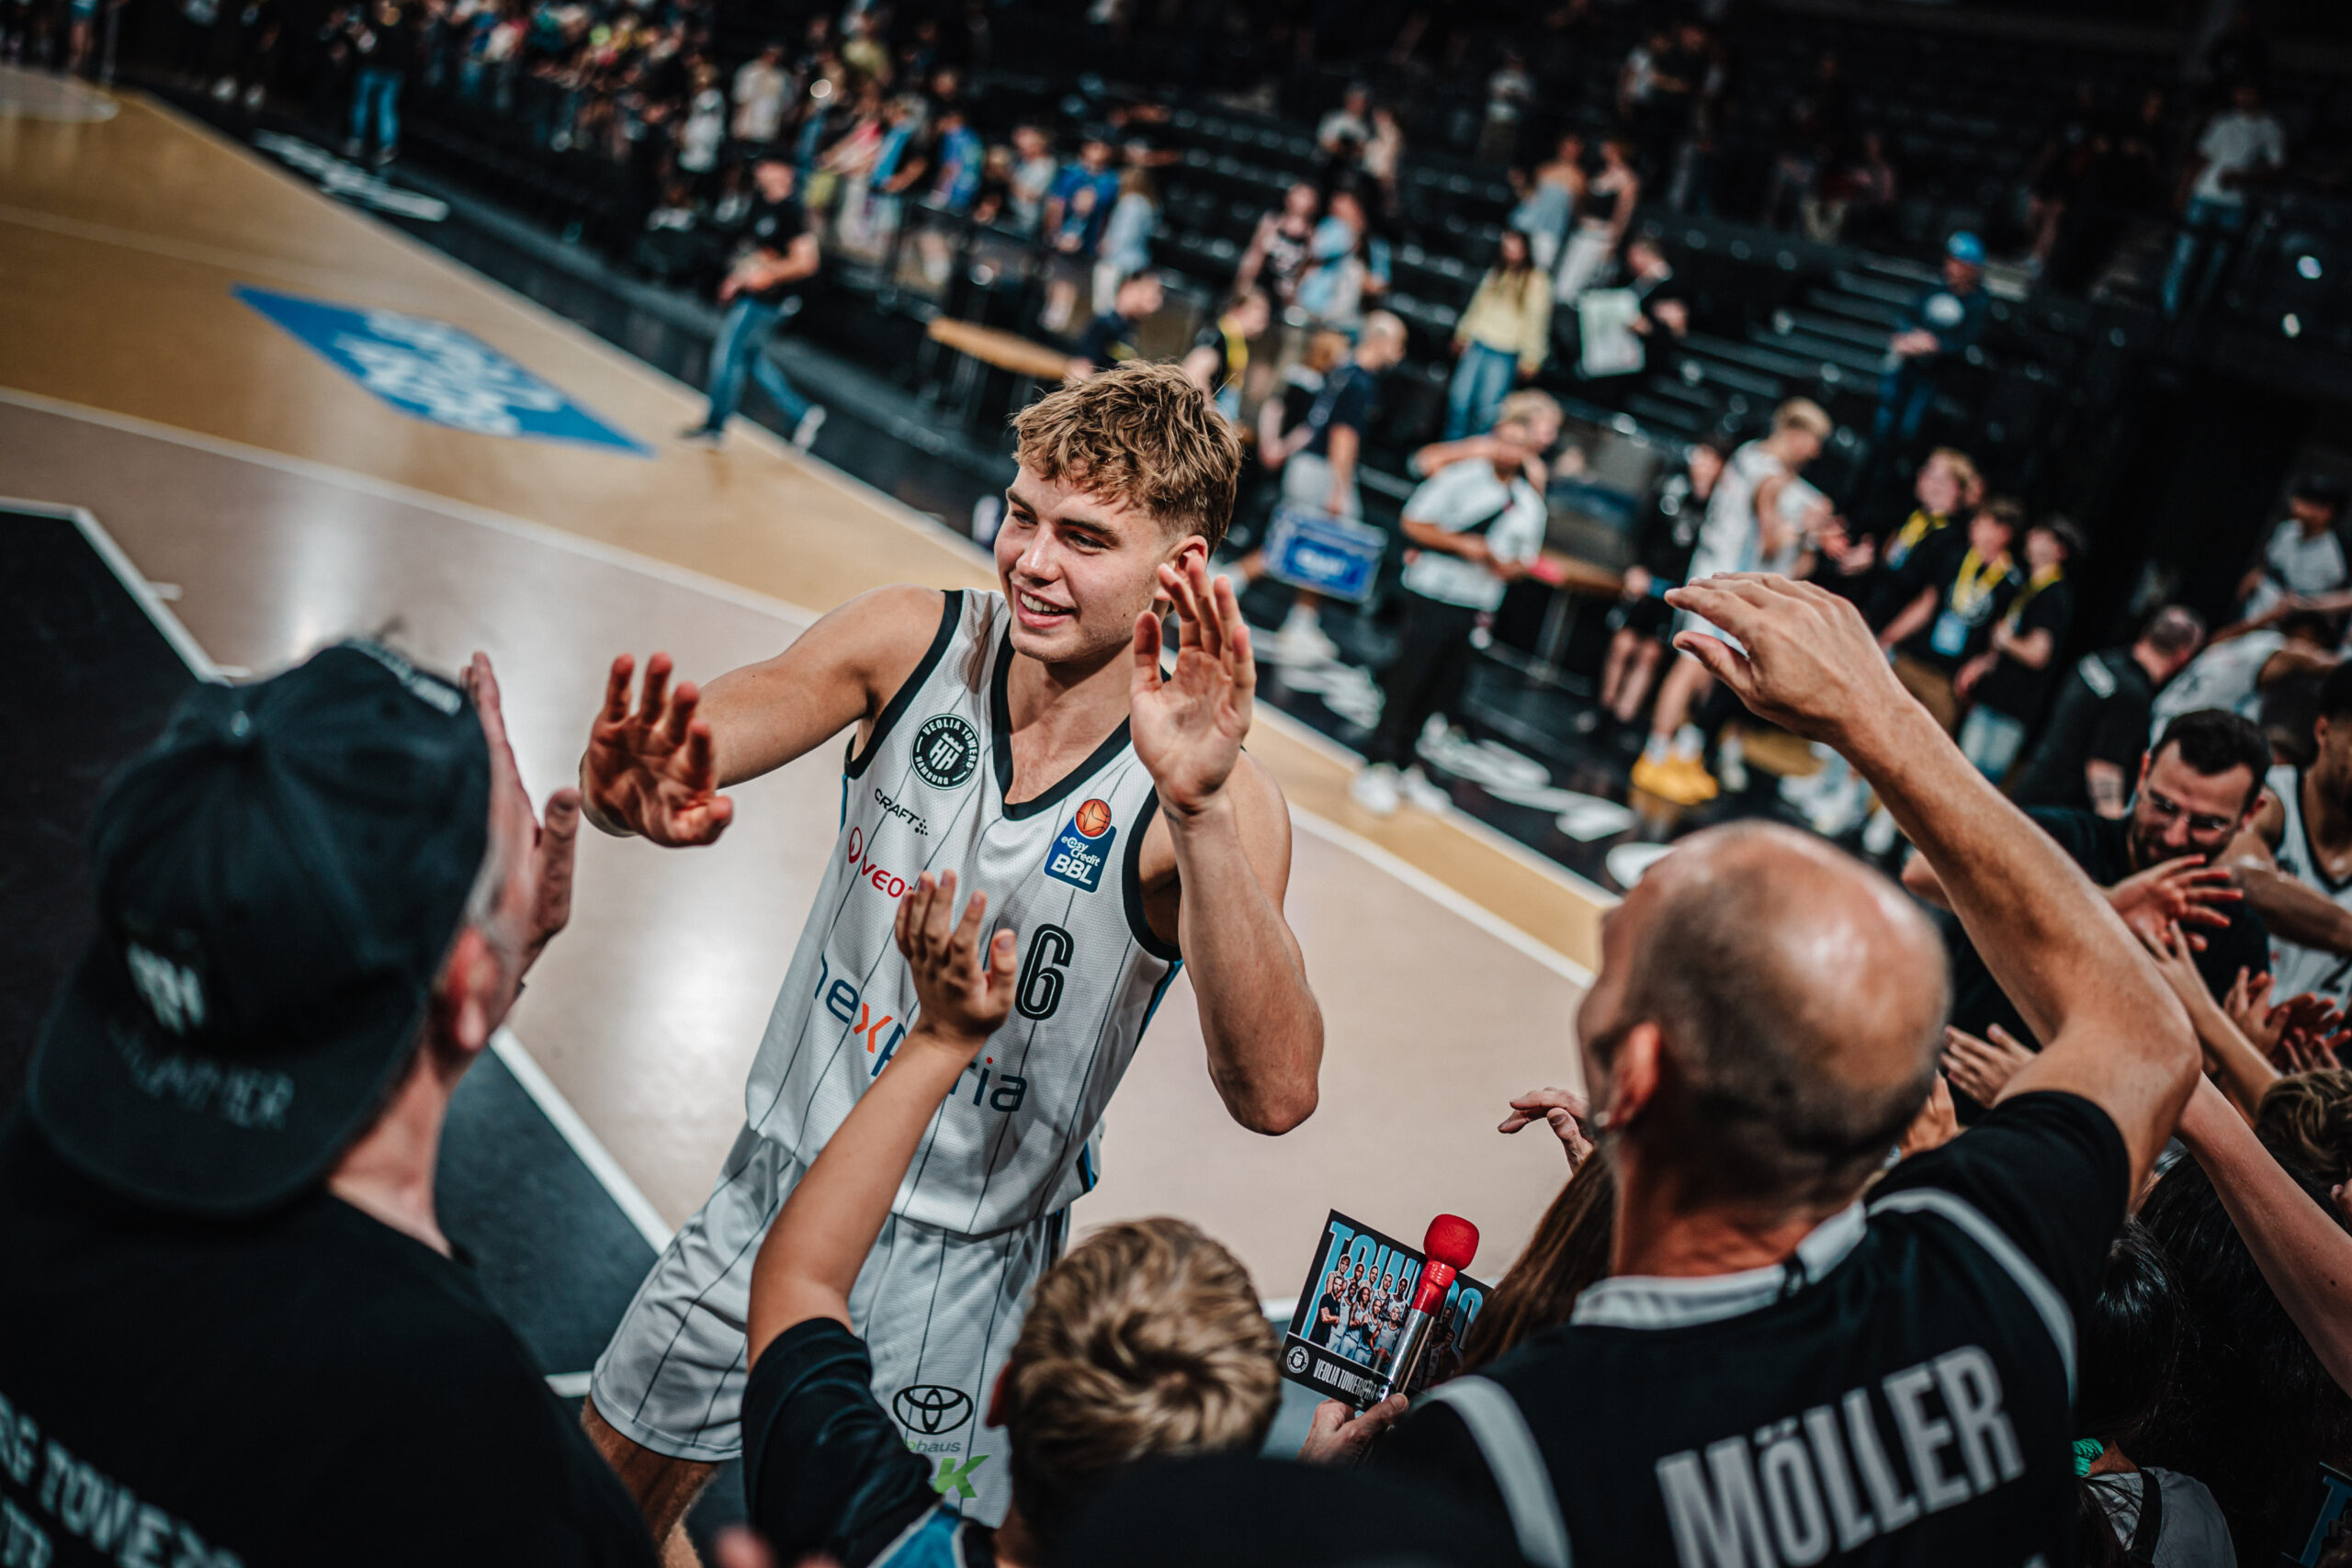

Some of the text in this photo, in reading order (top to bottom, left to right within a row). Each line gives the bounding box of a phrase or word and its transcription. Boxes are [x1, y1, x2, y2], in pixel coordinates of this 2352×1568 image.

[922, 718, 978, 769] VEOLIA TOWERS
[914, 755, 949, 784] HAMBURG
[874, 788, 920, 824] CRAFT
[1050, 853, 1092, 885] BBL
[1070, 848, 1101, 866] Credit
[862, 854, 913, 898] VEO
[1313, 1358, 1341, 1386] VEOLIA
[1656, 1345, 2024, 1568] MÖLLER
